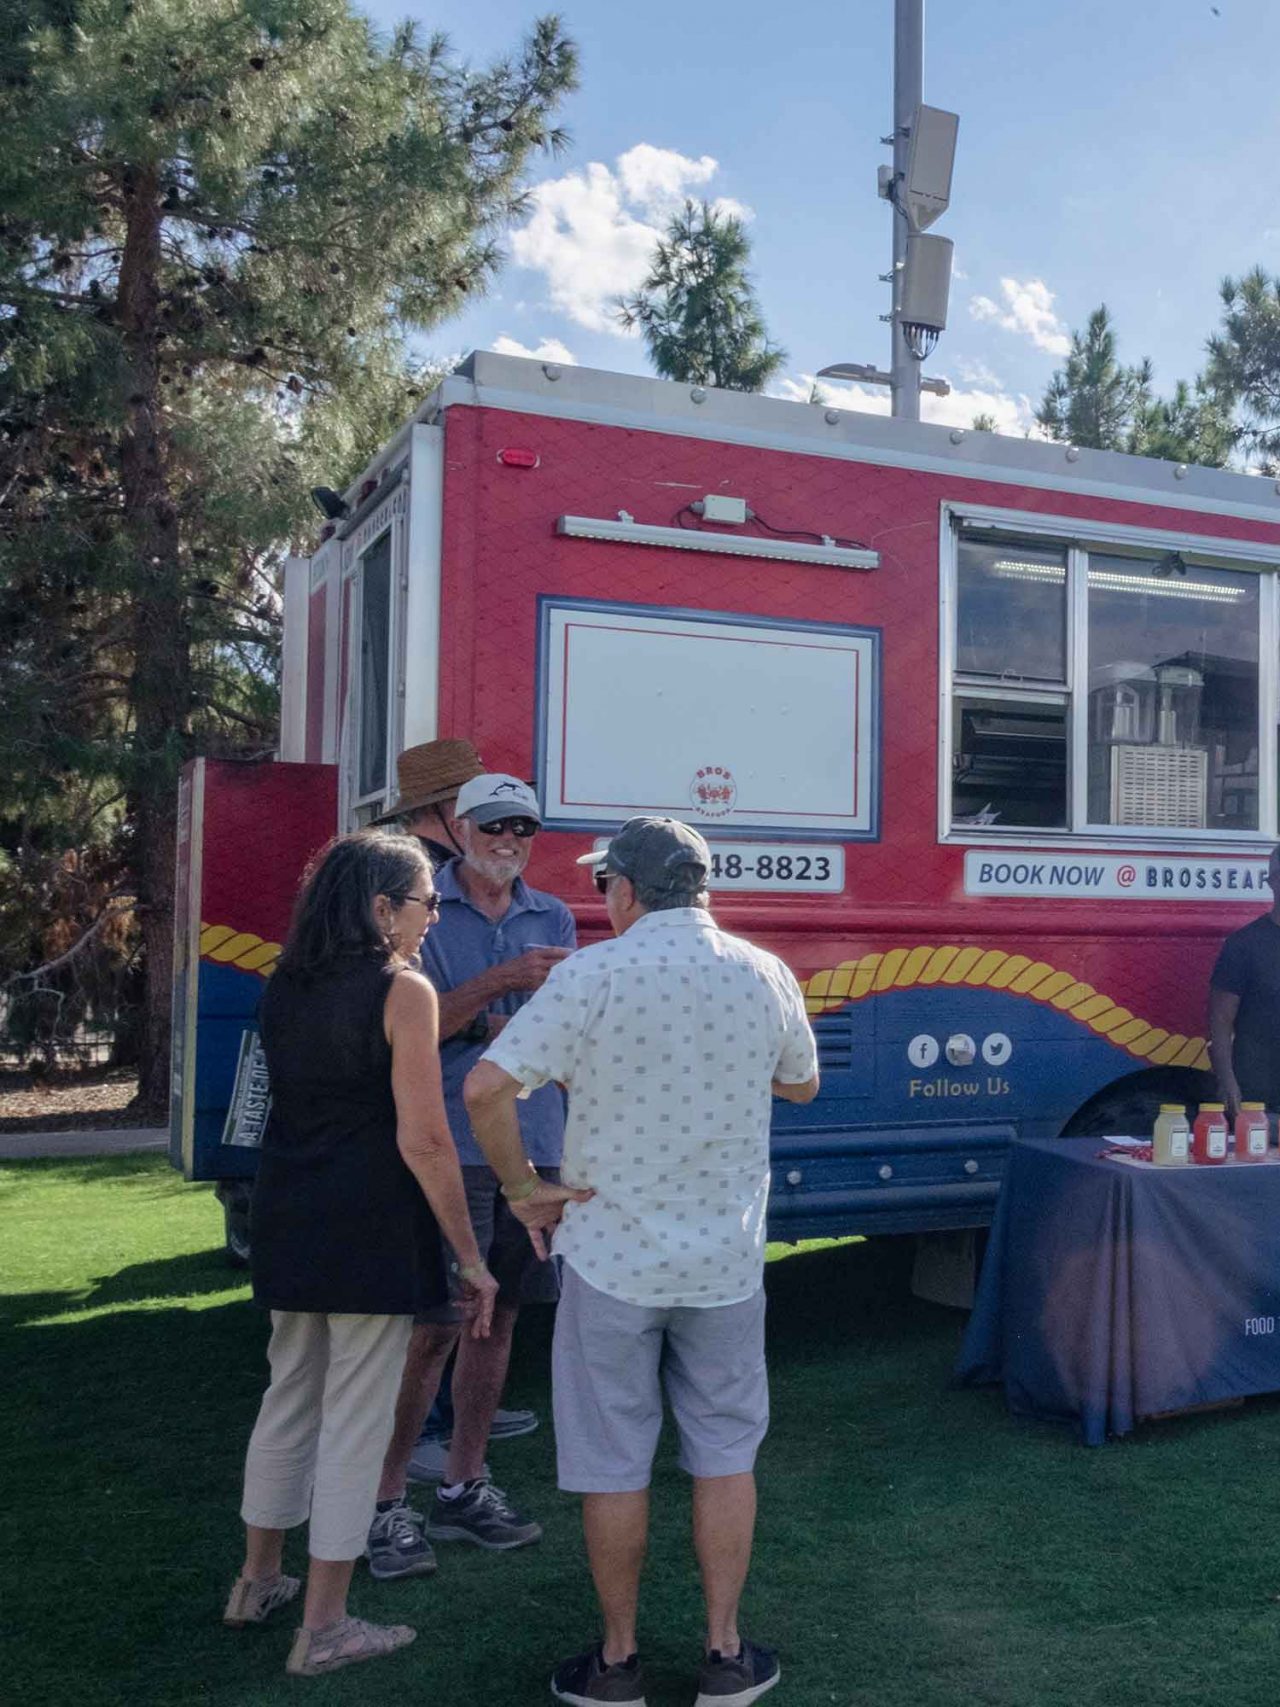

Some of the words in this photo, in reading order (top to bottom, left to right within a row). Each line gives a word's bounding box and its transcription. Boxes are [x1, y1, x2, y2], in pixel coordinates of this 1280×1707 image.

[709, 853, 831, 881] 48-8823
[979, 863, 1043, 884] BOOK
[1049, 865, 1103, 886] NOW
[1116, 864, 1136, 888] @
[909, 1079, 980, 1098] Follow
[988, 1077, 1010, 1095] Us
[241, 1083, 269, 1126] TASTE
[1245, 1317, 1275, 1336] FOOD
